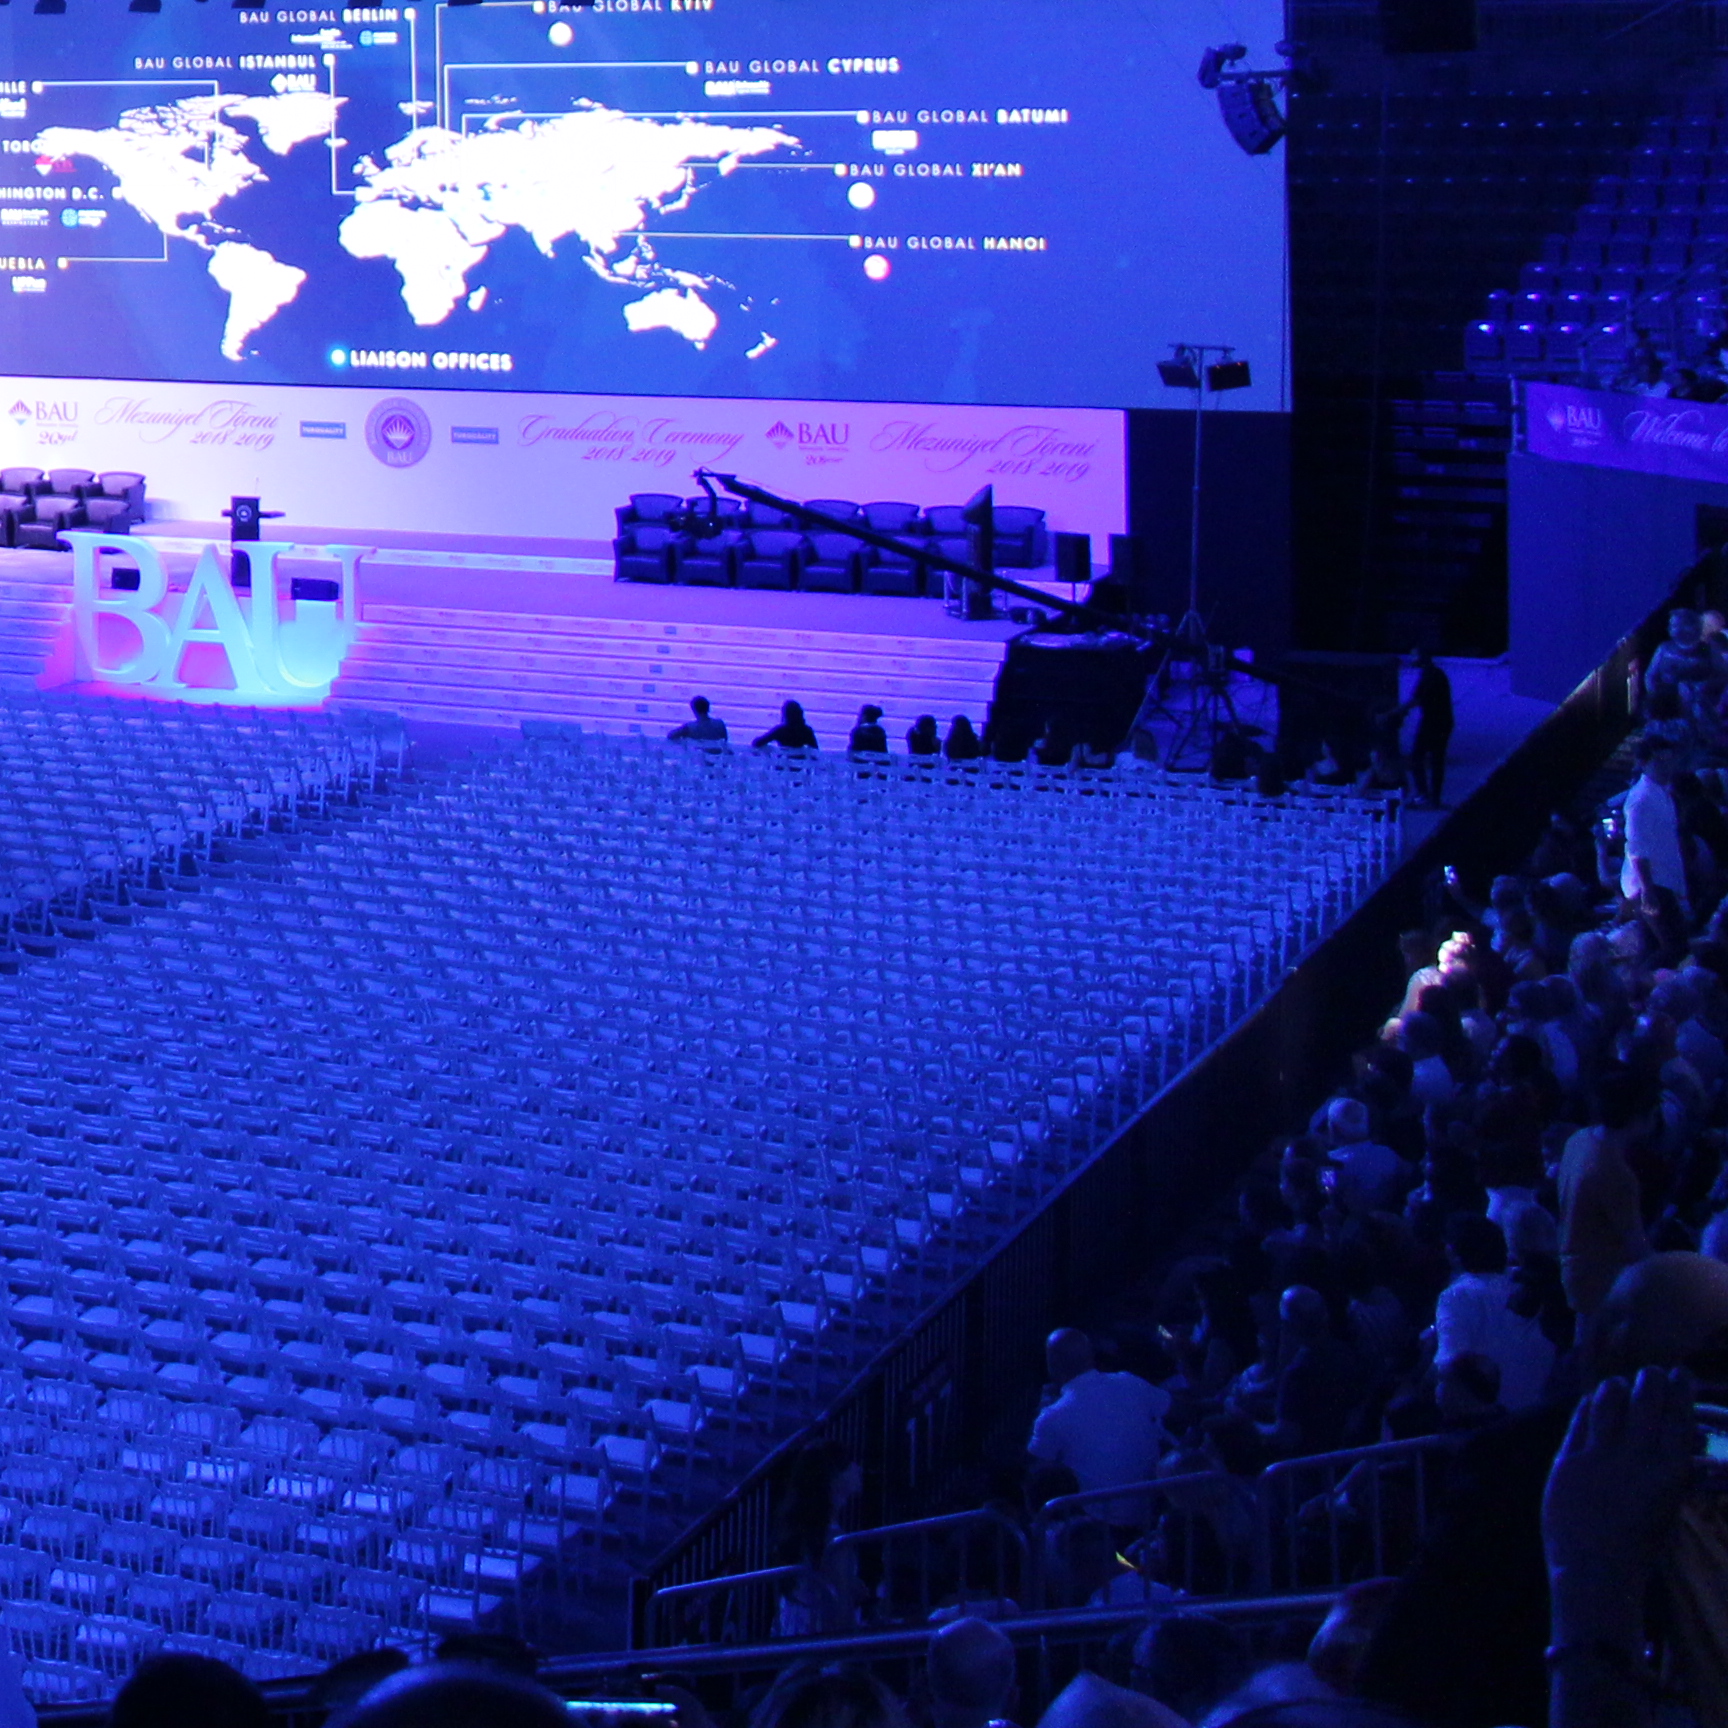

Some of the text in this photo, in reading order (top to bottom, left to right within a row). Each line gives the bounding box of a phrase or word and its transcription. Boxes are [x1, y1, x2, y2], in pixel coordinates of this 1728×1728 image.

[240, 7, 398, 23] BAU GLOBAL BERLIN
[135, 54, 317, 70] BAU GLOBAL ISTANBUL
[705, 58, 900, 74] BAU GLOBAL CYPRUS
[872, 108, 1070, 124] BAU GLOBAL BATUMI
[849, 164, 885, 177] BAU
[894, 163, 964, 177] GLOBAL
[71, 188, 105, 200] D.C.
[864, 236, 1046, 251] BAU GLOBAL HANOI
[350, 350, 514, 371] LIAISON OFFICES
[35, 400, 80, 422] BAU
[1566, 405, 1602, 430] BAU
[517, 410, 745, 465] Graduation Ceremony
[797, 422, 850, 445] BAU
[386, 451, 413, 463] BAU
[57, 531, 377, 697] BAU
